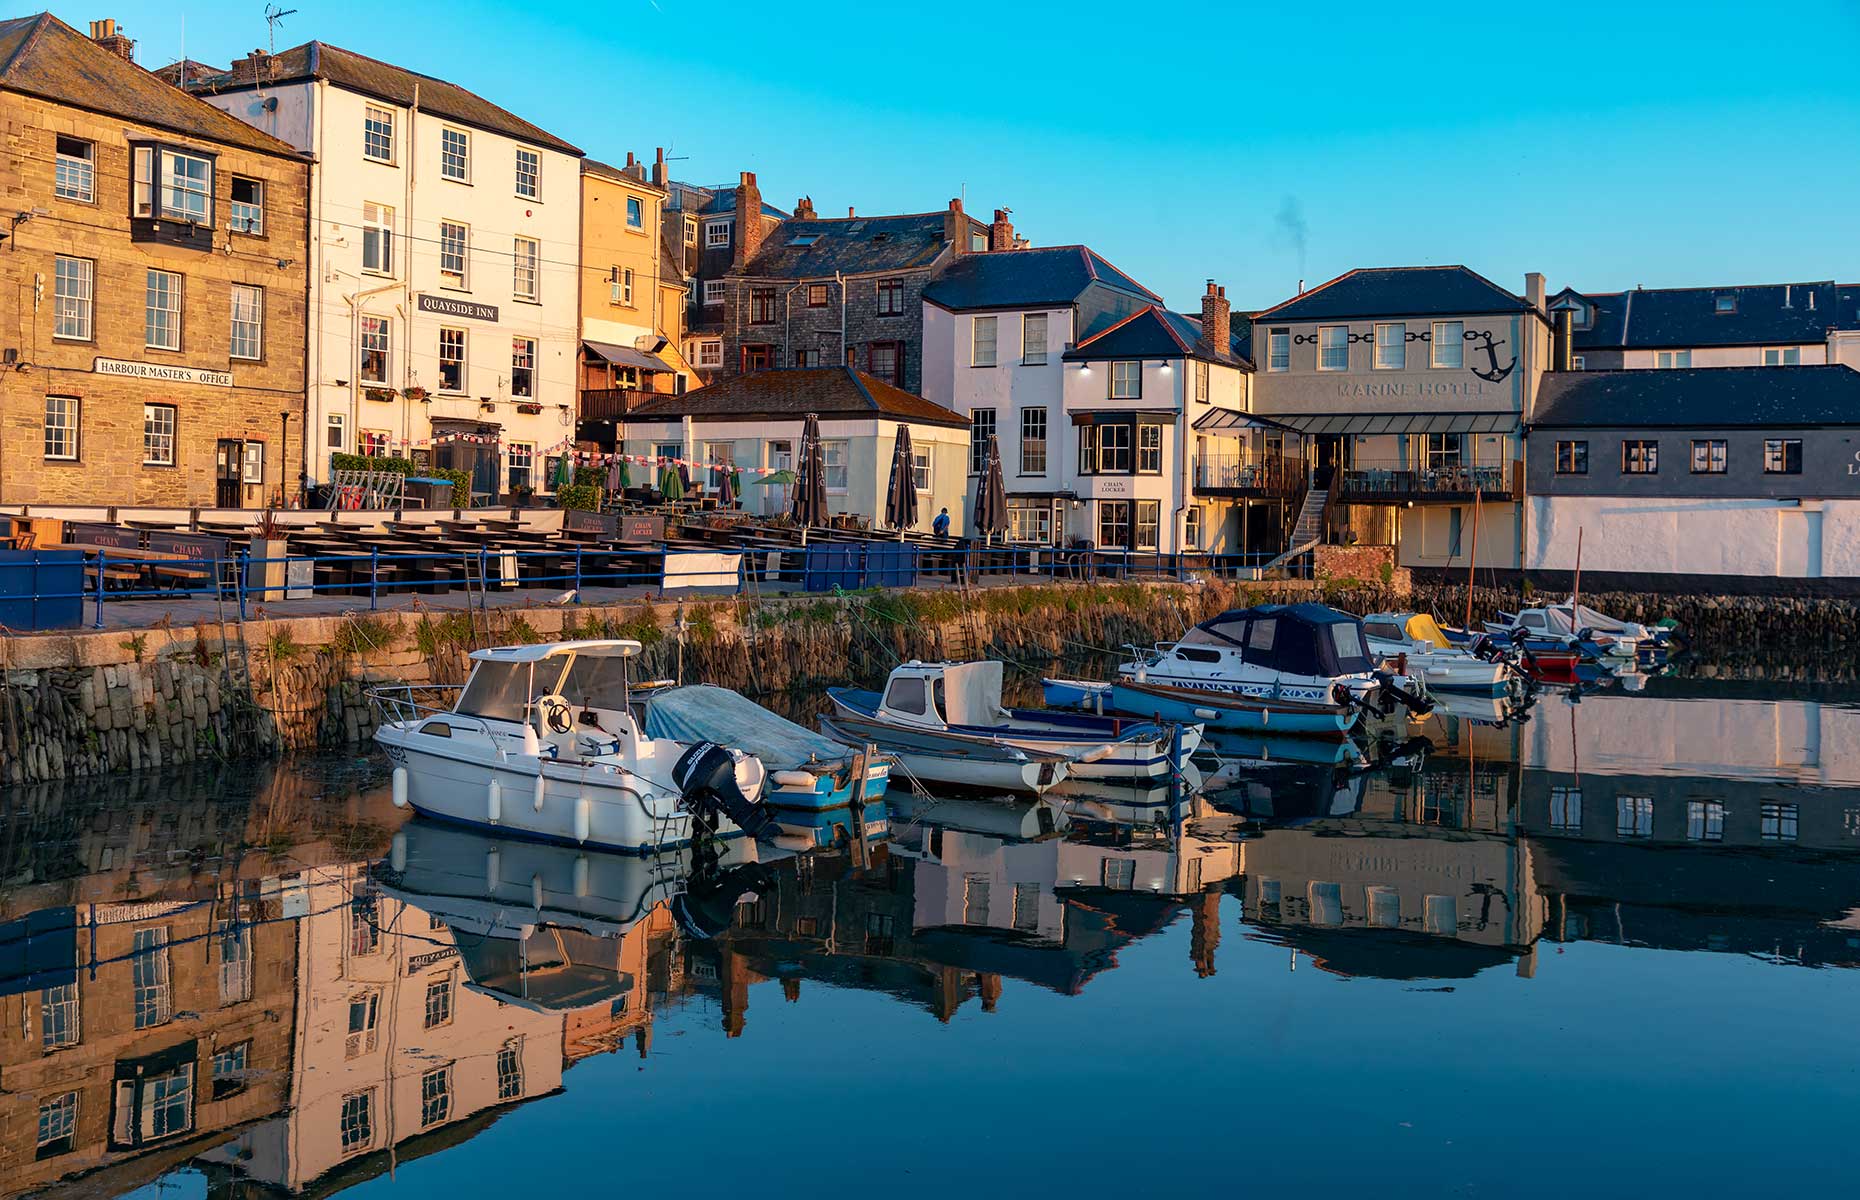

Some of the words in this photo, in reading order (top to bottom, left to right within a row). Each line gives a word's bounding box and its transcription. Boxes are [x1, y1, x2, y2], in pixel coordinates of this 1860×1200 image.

[423, 297, 474, 316] QUAYSIDE
[476, 306, 495, 318] INN
[101, 361, 147, 376] HARBOUR
[148, 366, 192, 381] MASTER'S
[199, 372, 229, 385] OFFICE
[1337, 383, 1410, 397] MARINE
[1419, 382, 1484, 395] HOTEL
[94, 535, 120, 546] CHAIN
[172, 543, 203, 556] CHAIN
